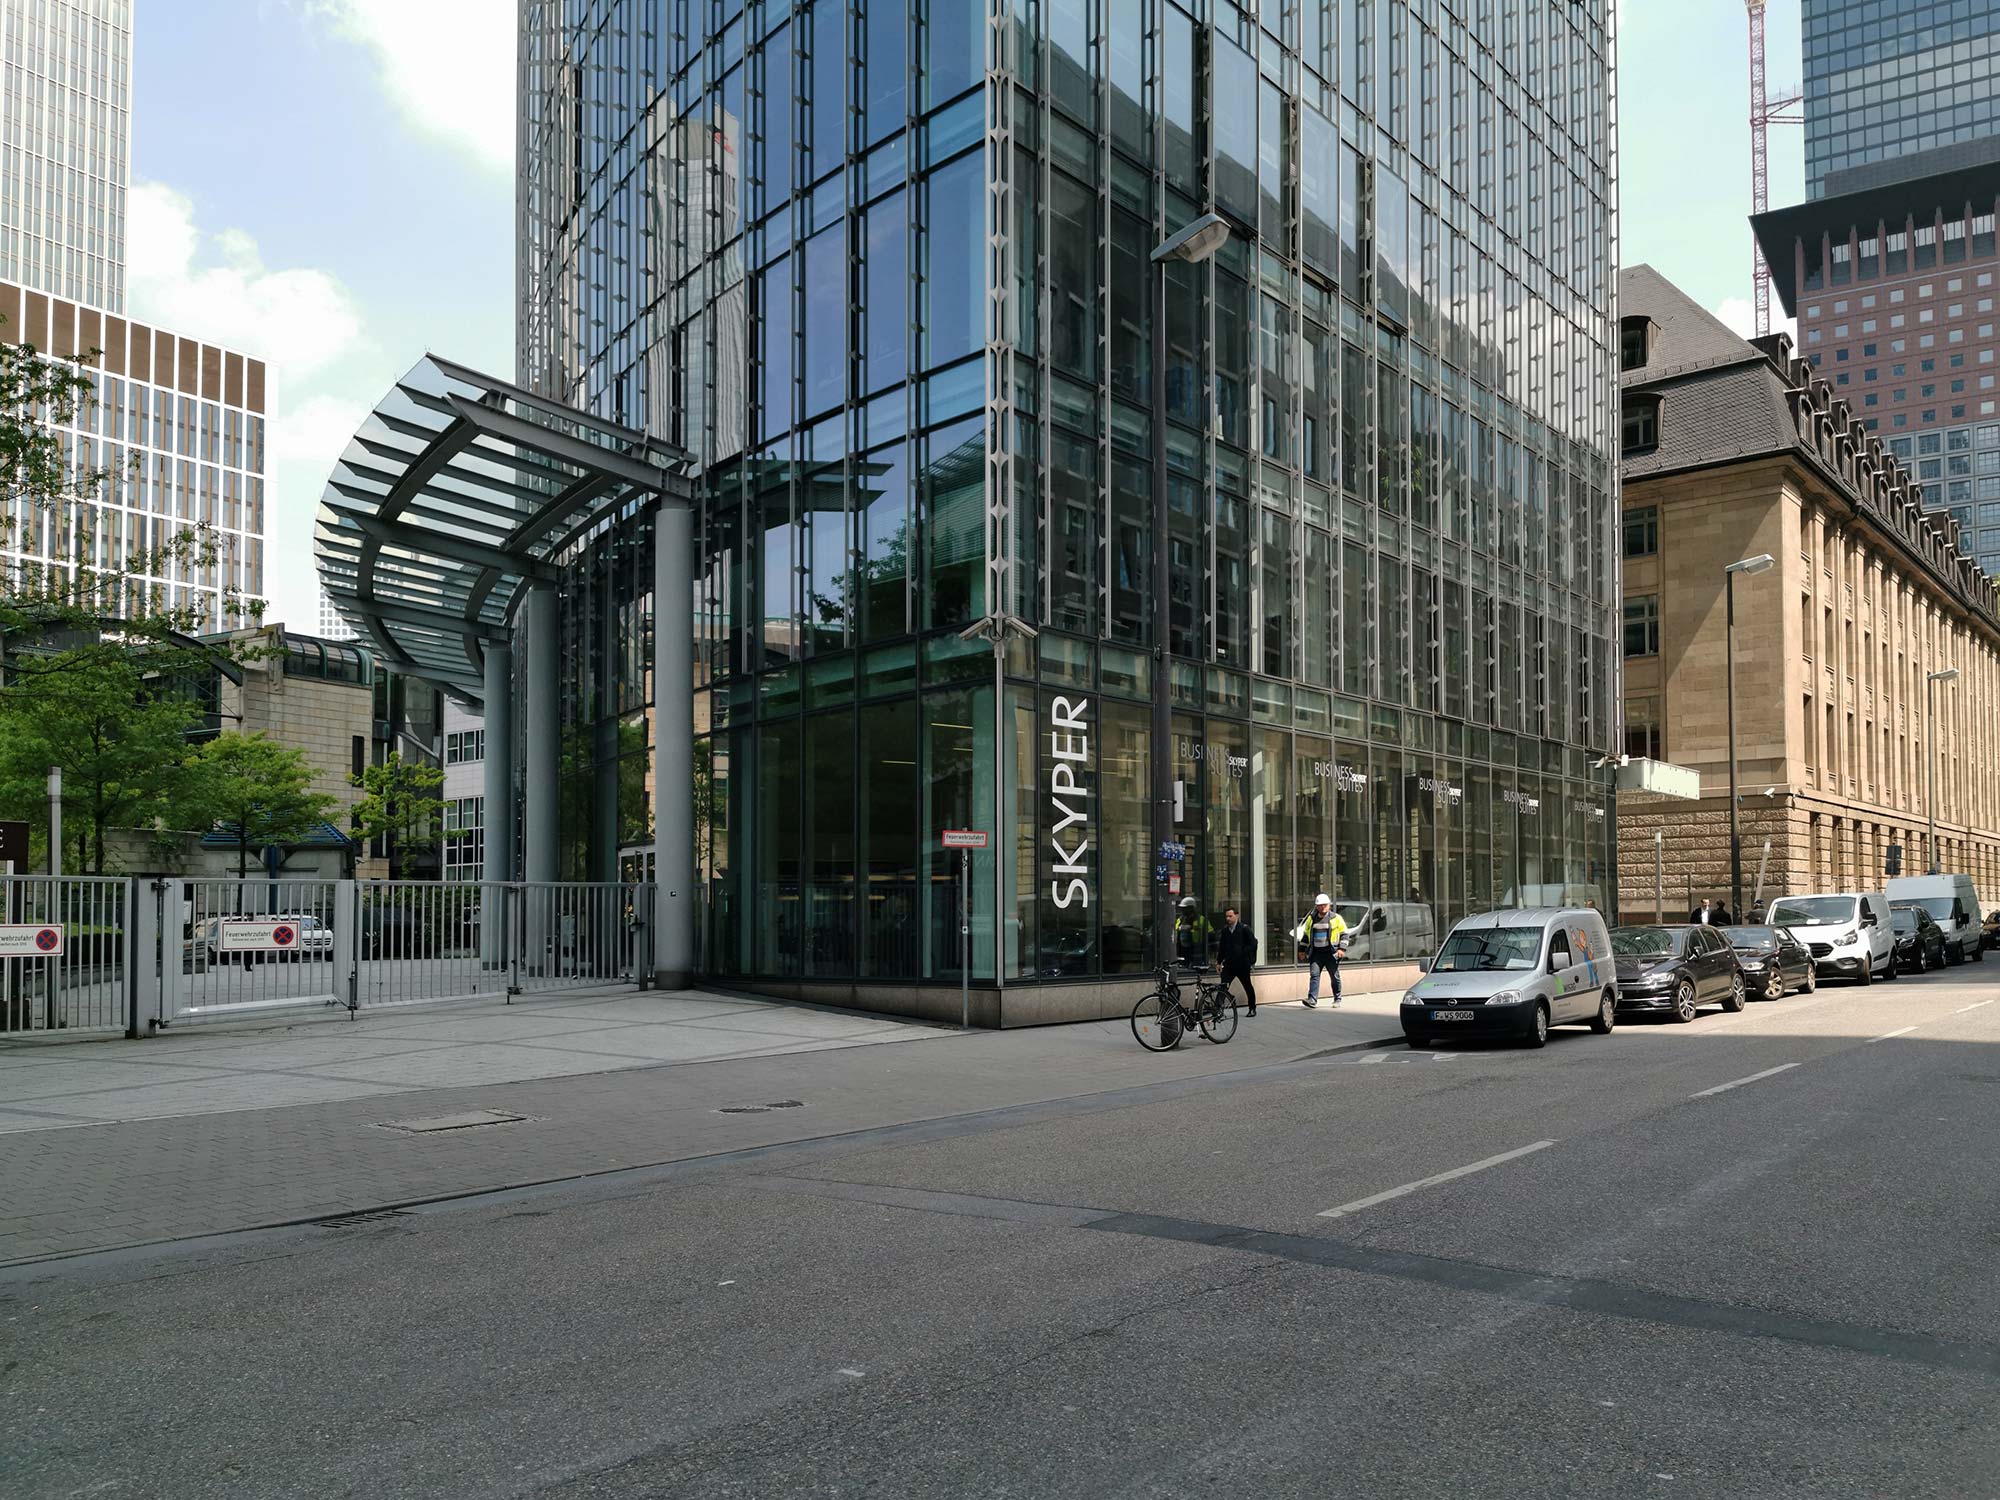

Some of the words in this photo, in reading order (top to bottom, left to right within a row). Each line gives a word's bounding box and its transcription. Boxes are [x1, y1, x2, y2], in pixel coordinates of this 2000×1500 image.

[1180, 742, 1230, 761] BUSINESS
[1314, 761, 1353, 780] BUSINESS
[1338, 777, 1364, 792] SUITES
[1419, 777, 1451, 792] BUSINESS
[1052, 696, 1088, 909] SKYPER
